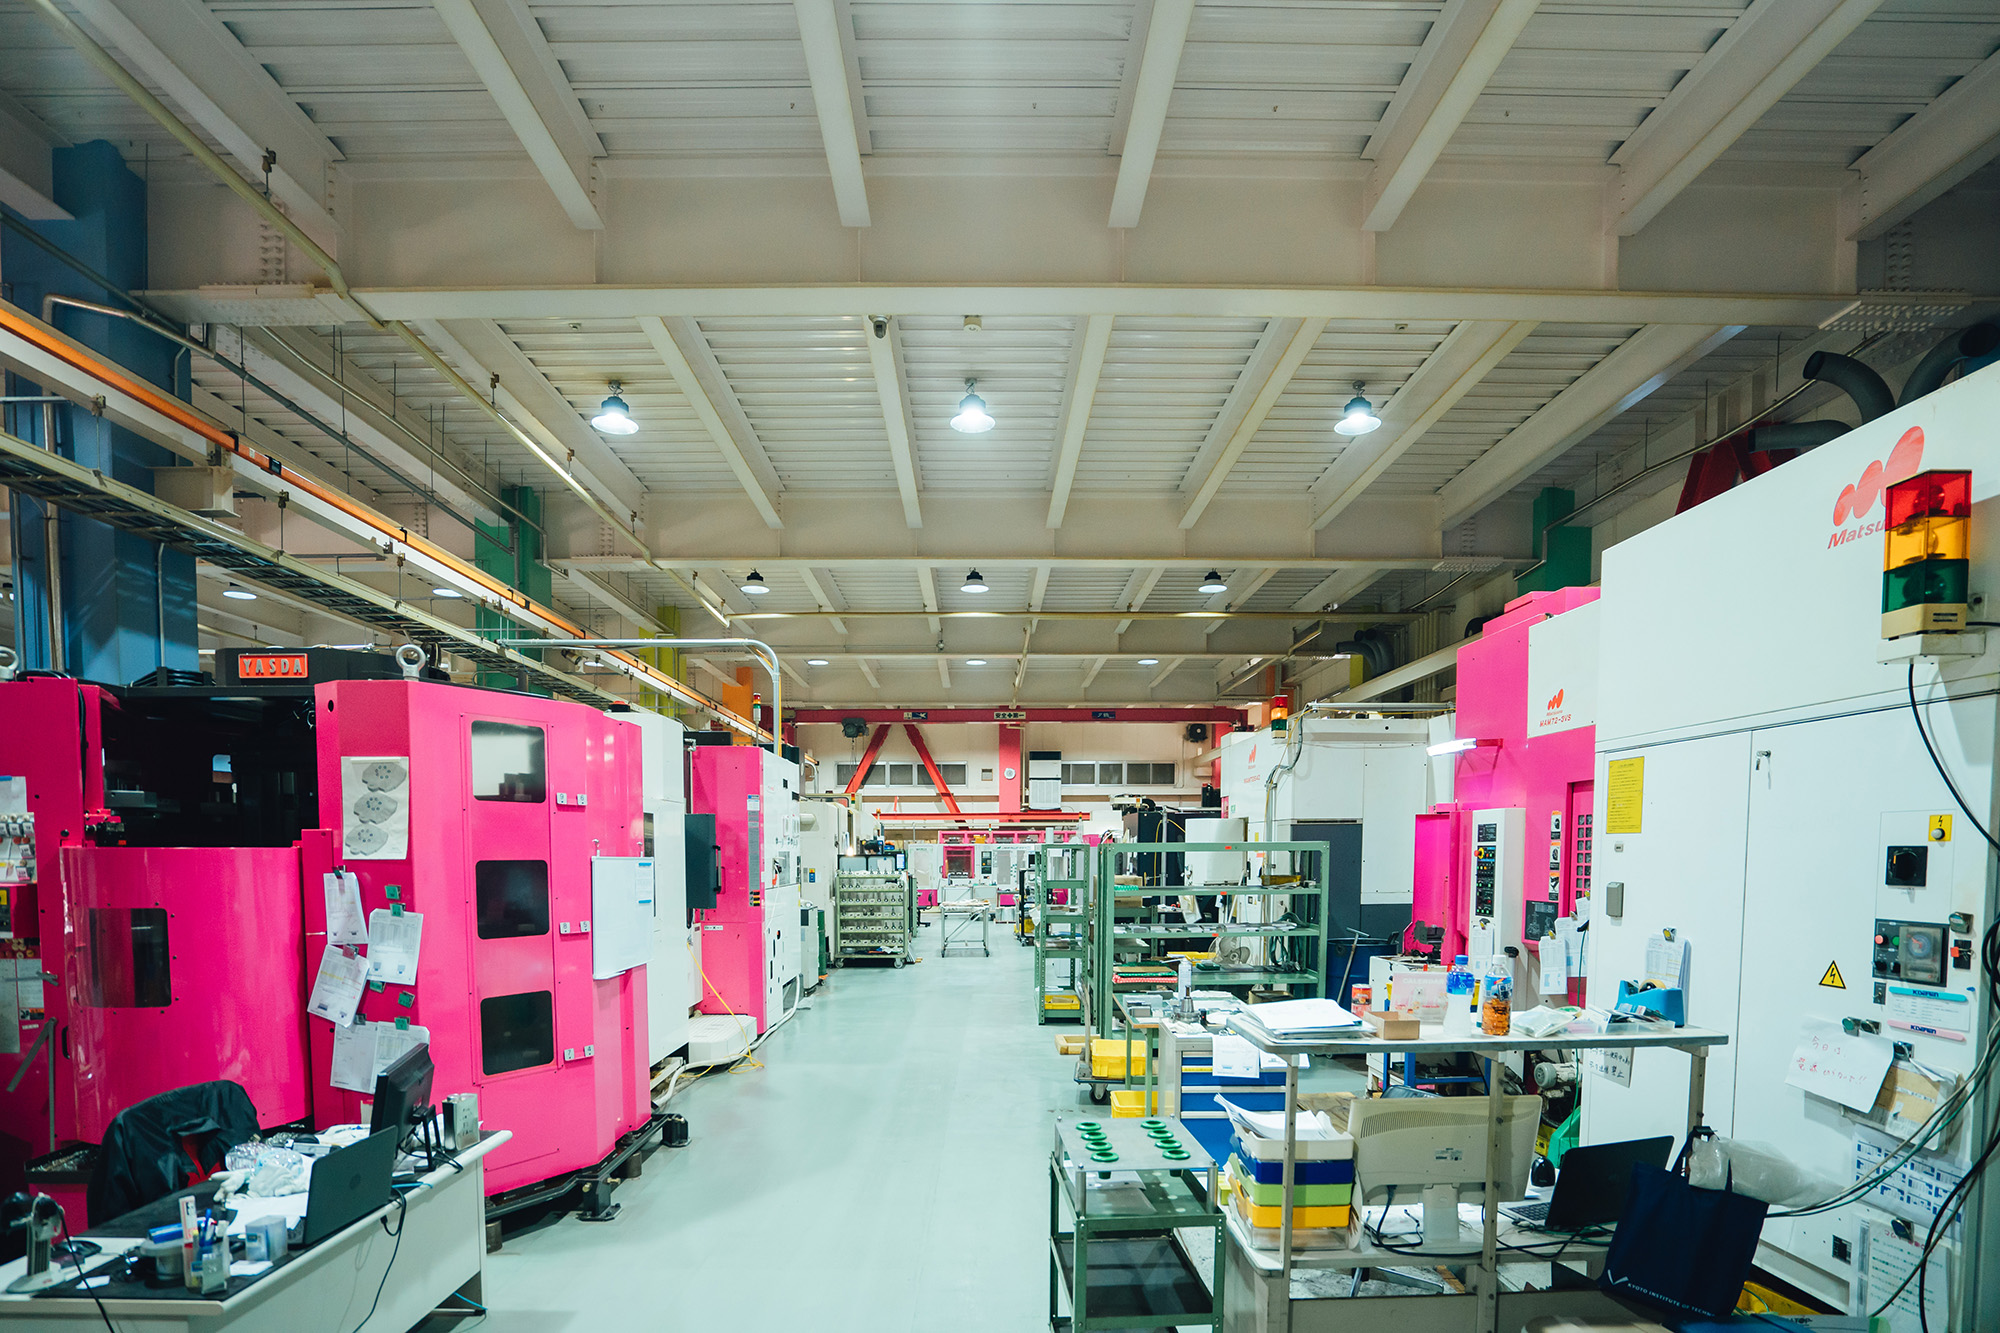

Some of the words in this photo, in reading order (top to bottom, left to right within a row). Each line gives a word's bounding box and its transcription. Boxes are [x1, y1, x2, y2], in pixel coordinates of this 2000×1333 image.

[1828, 520, 1886, 549] Matsu
[243, 658, 302, 674] YASDA
[1627, 1283, 1648, 1294] KYOTO
[1649, 1291, 1680, 1306] INSTITUTE
